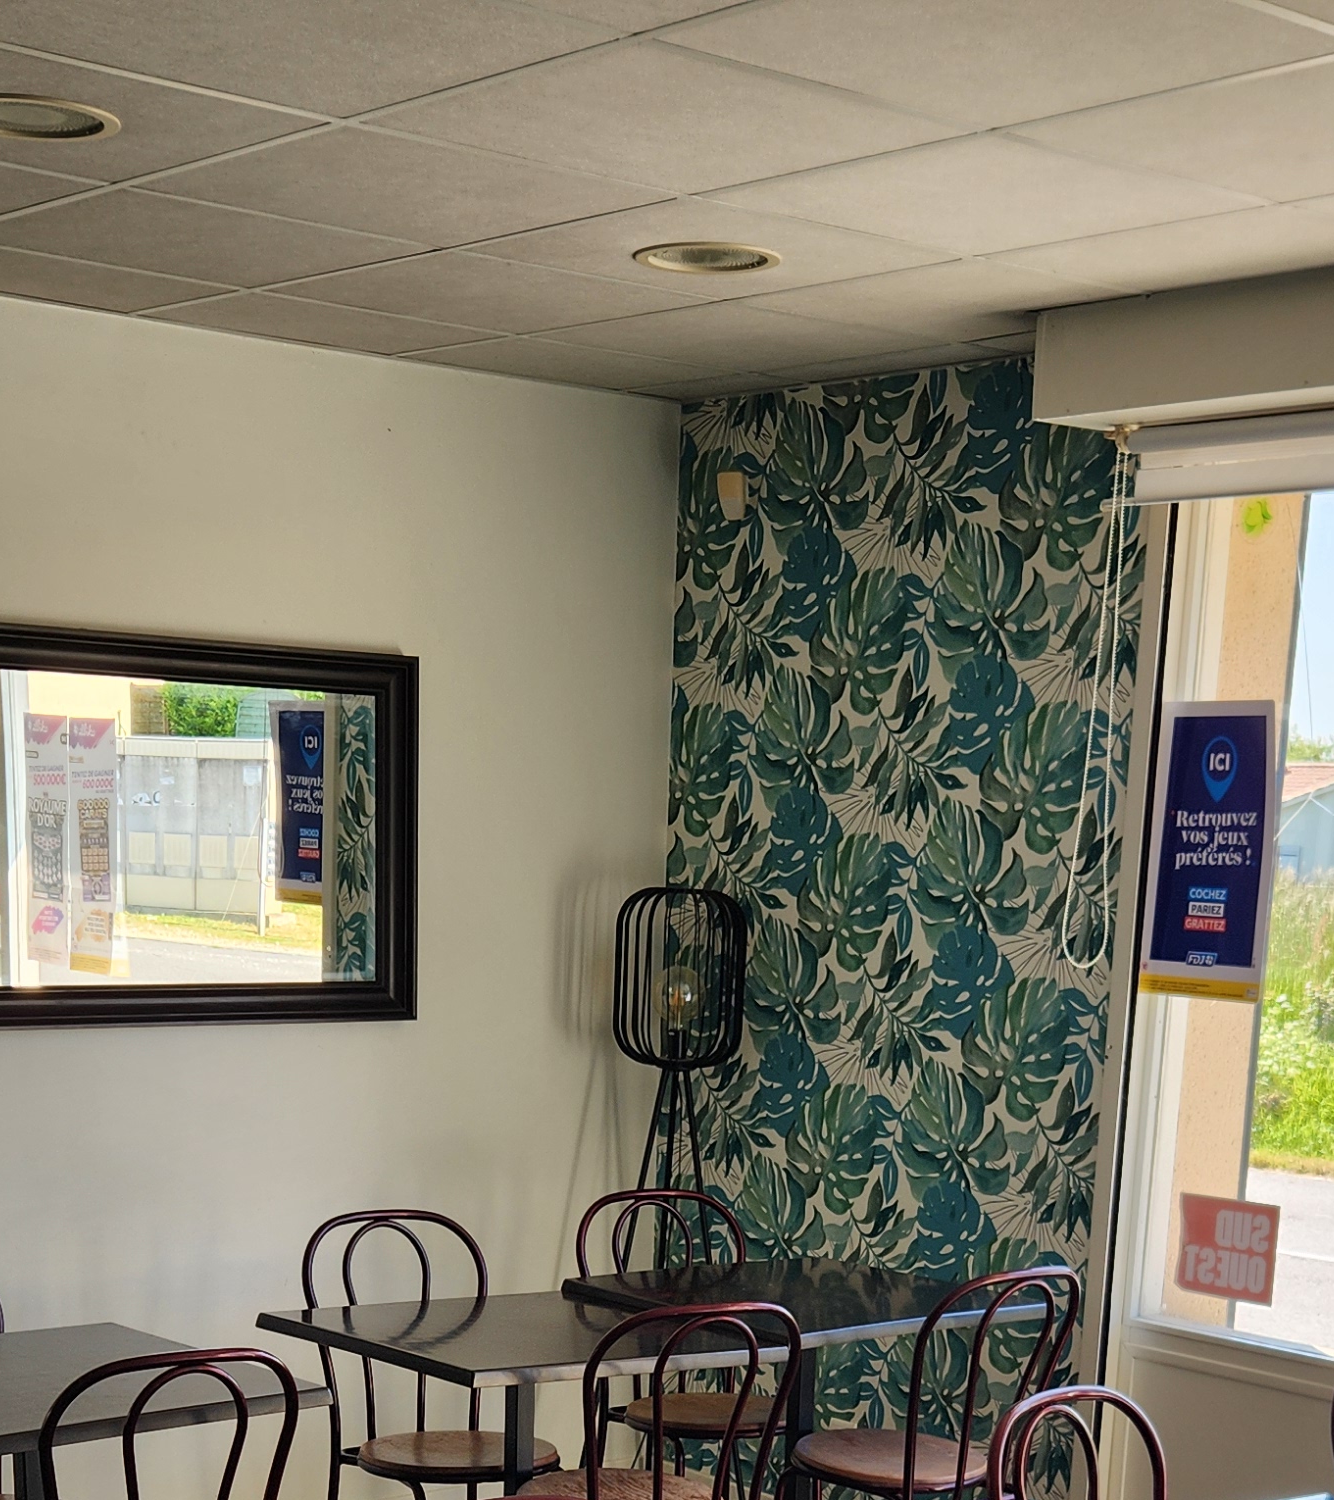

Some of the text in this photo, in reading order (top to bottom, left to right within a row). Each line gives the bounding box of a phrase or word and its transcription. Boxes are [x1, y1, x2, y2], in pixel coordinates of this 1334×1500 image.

[1209, 752, 1230, 771] ICI
[28, 797, 67, 814] ROYAUME
[80, 809, 107, 819] CARATS
[1176, 809, 1257, 828] Retrouvez
[37, 814, 57, 828] D'OR
[1181, 828, 1249, 850] vos jeux
[1189, 887, 1226, 900] COCHEZ
[1191, 903, 1222, 915] PARIEZ
[1186, 918, 1226, 930] GRATTEZ
[1188, 954, 1207, 966] FDJ
